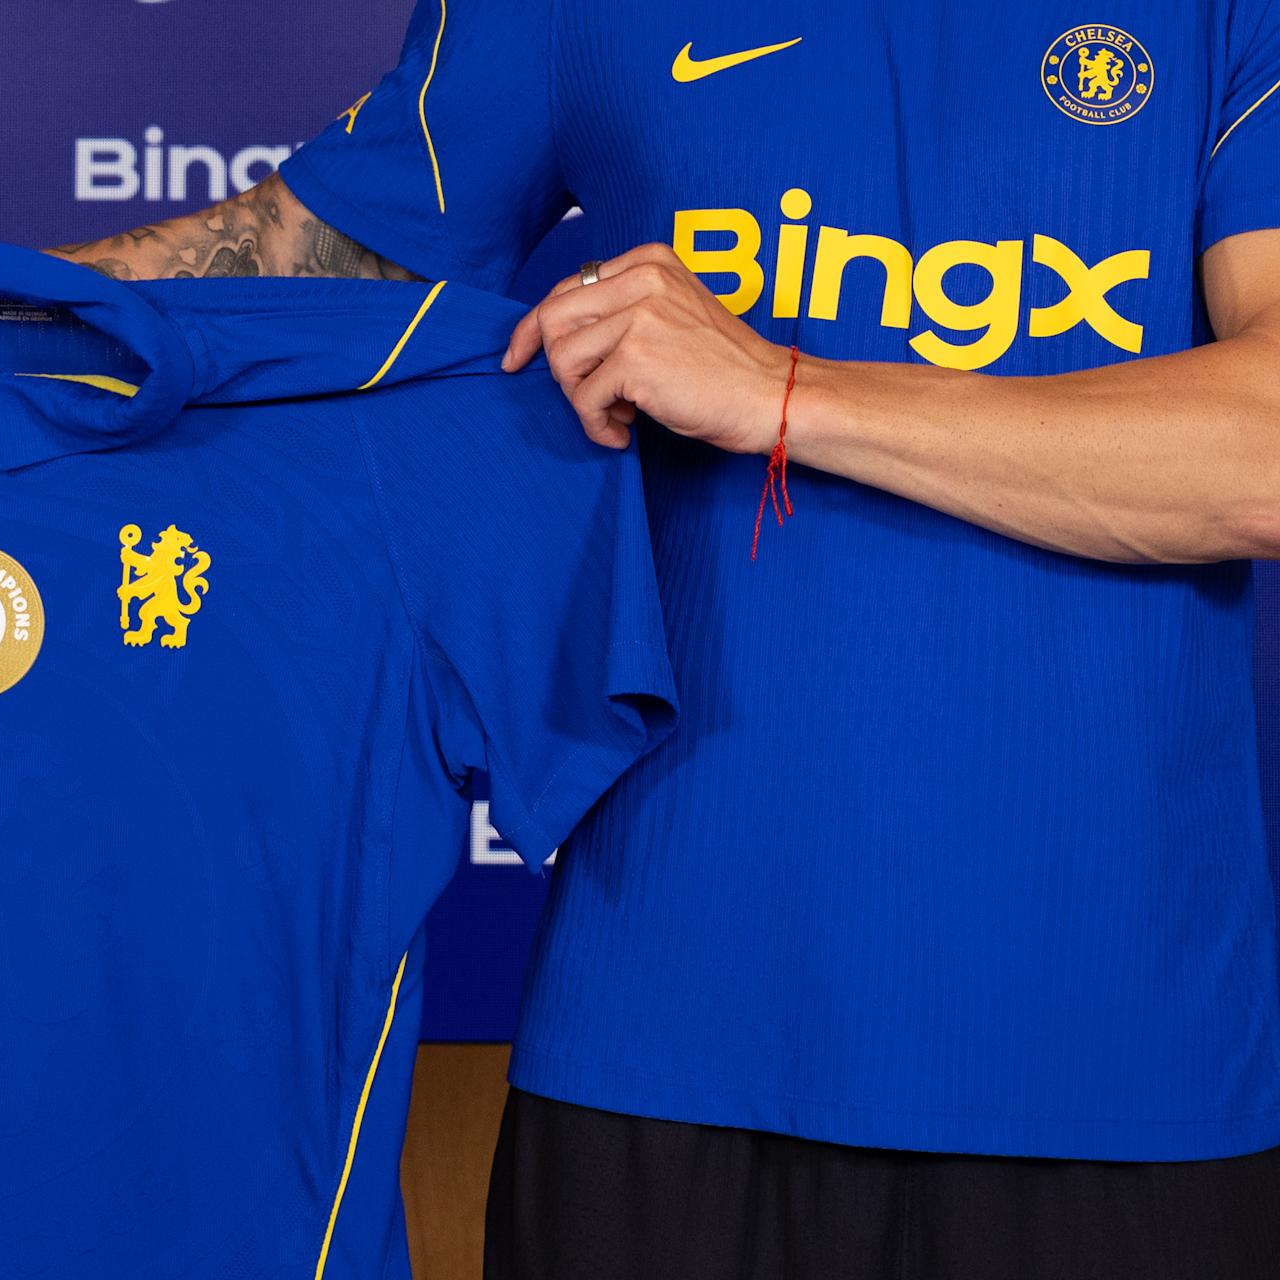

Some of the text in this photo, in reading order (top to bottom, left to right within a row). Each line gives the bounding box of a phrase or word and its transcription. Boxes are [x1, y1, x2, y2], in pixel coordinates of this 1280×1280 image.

[1065, 28, 1133, 53] CHELSEA
[1059, 95, 1132, 119] FOOTBALL CLUB
